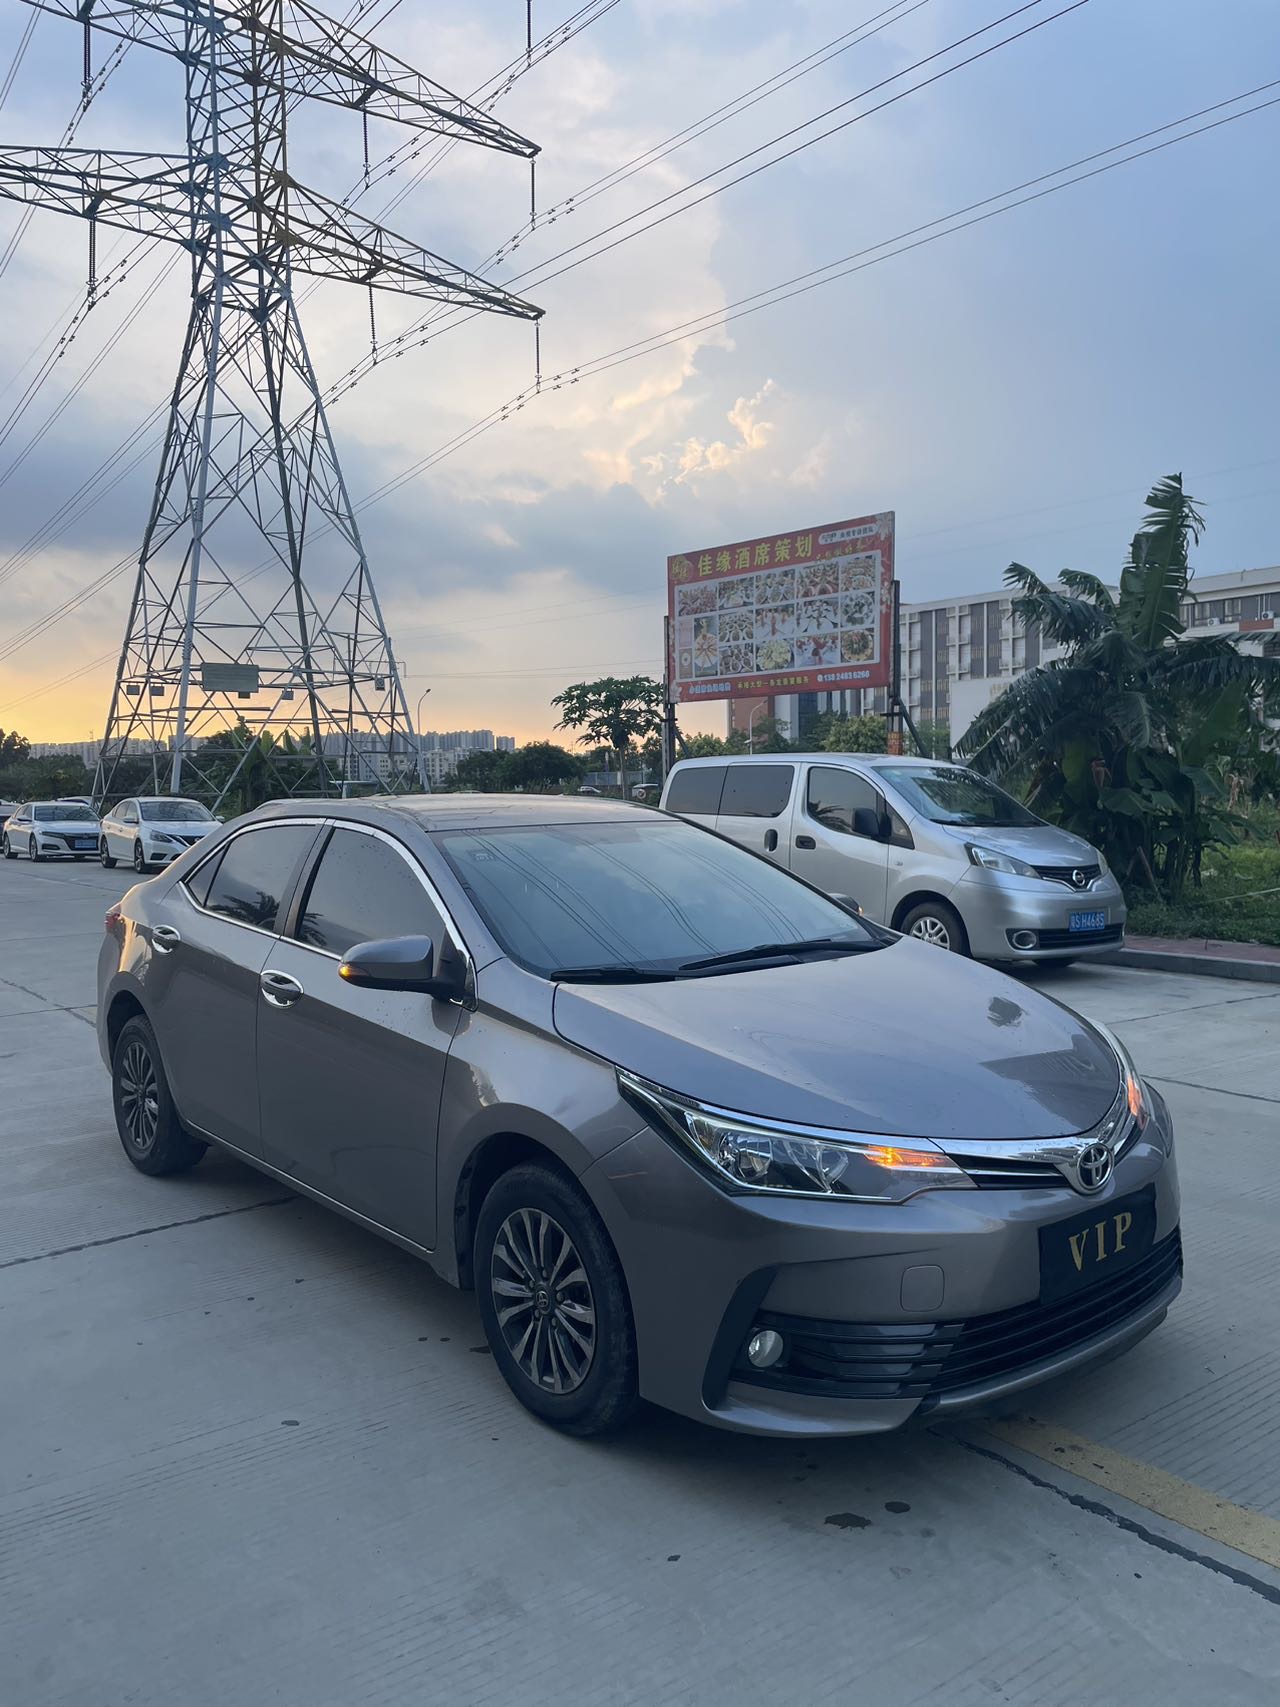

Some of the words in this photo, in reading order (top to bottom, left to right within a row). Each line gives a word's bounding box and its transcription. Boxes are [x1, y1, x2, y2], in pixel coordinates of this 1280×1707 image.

[698, 534, 813, 577] 佳缘酒席策划
[1068, 1212, 1133, 1272] VIP
